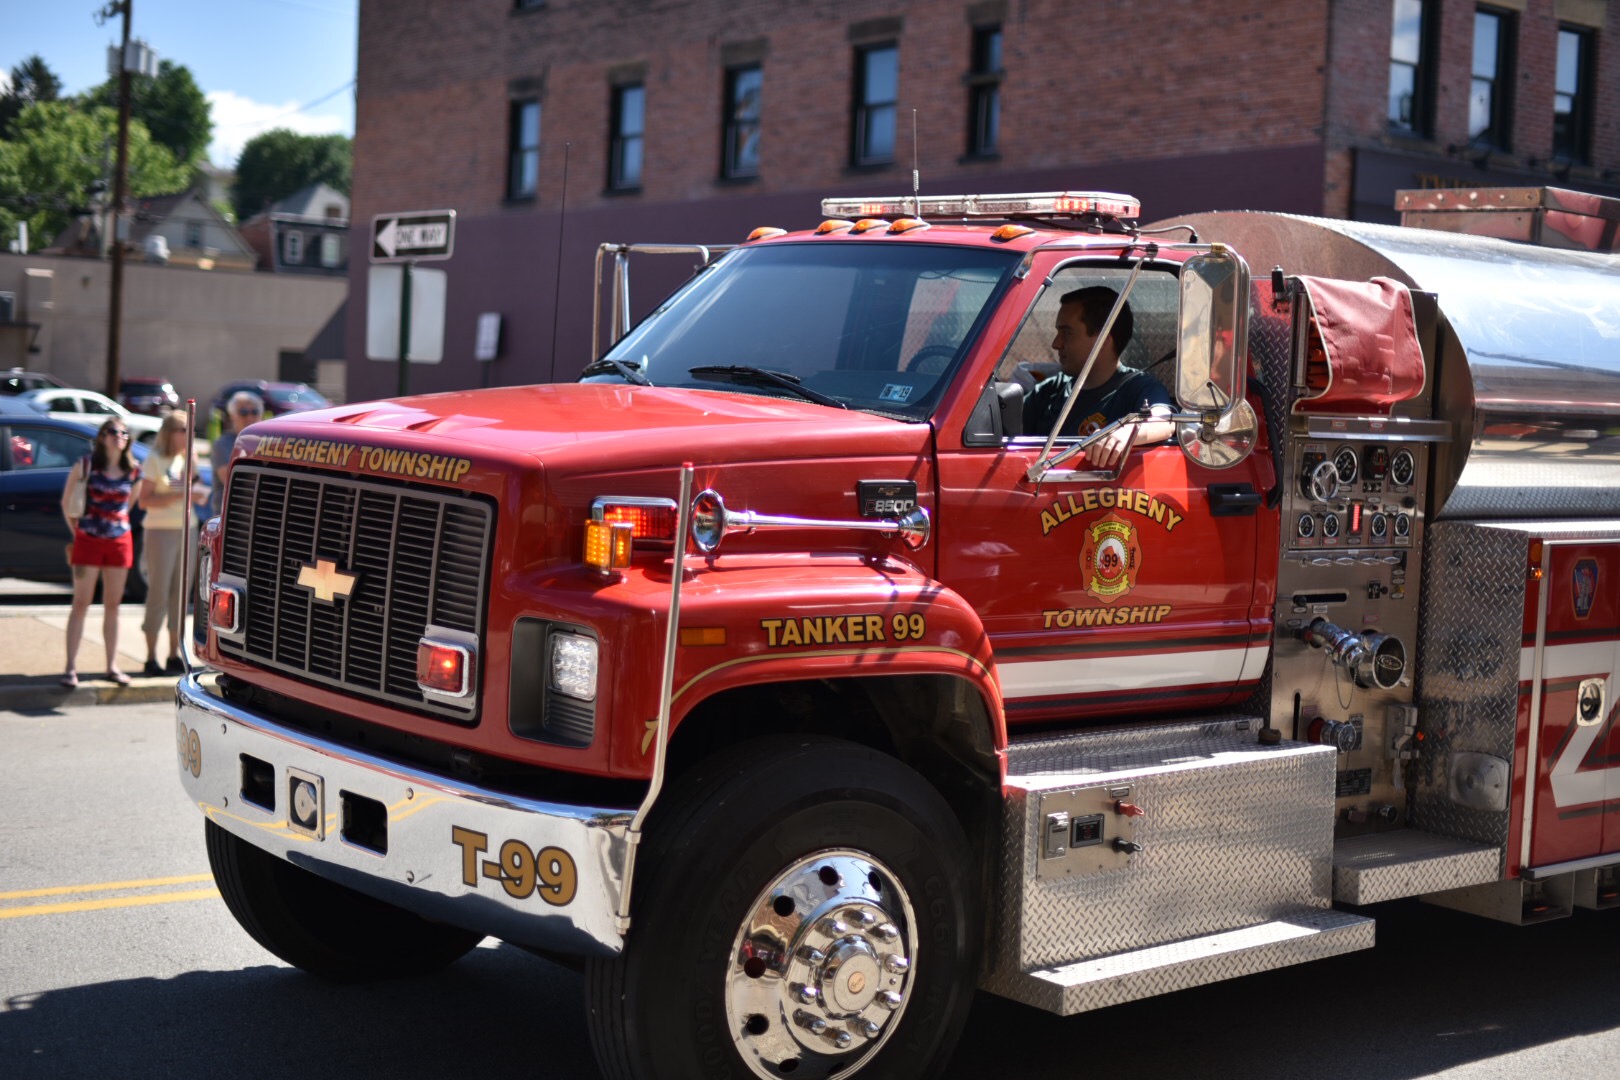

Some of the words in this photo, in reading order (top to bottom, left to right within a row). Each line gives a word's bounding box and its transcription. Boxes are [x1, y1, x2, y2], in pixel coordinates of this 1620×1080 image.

[421, 227, 443, 244] WAY
[254, 435, 355, 468] ALLEGHENY
[358, 446, 472, 483] TOWNSHIP
[1040, 486, 1184, 536] ALLEGHENY
[1103, 553, 1118, 567] 99
[761, 614, 886, 647] TANKER
[892, 612, 925, 640] 99
[1042, 604, 1172, 629] TOWNSHIP
[177, 722, 202, 779] 99
[452, 824, 578, 907] T-99
